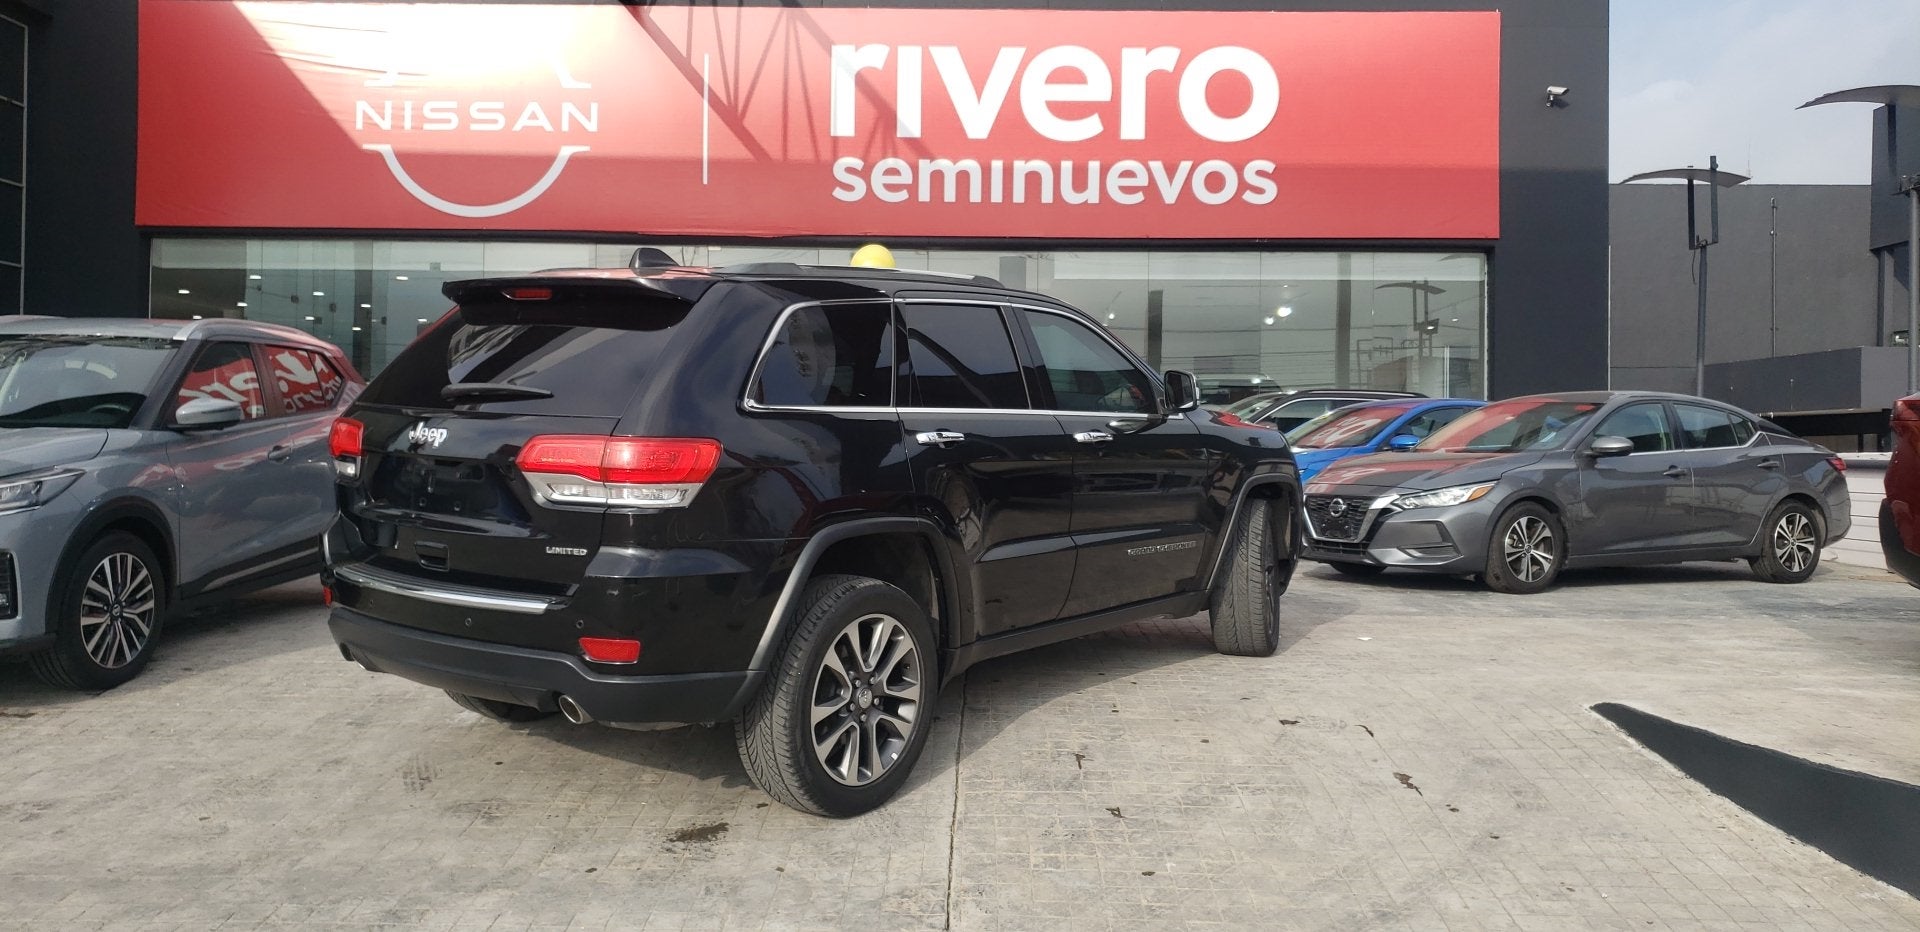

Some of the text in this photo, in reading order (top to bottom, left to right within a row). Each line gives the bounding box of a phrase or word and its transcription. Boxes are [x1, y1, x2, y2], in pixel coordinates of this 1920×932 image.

[830, 43, 1280, 143] rivero
[355, 100, 599, 132] NISSAN
[831, 154, 1279, 205] seminuevos
[408, 421, 448, 448] Jeep
[546, 546, 588, 556] LIMITED
